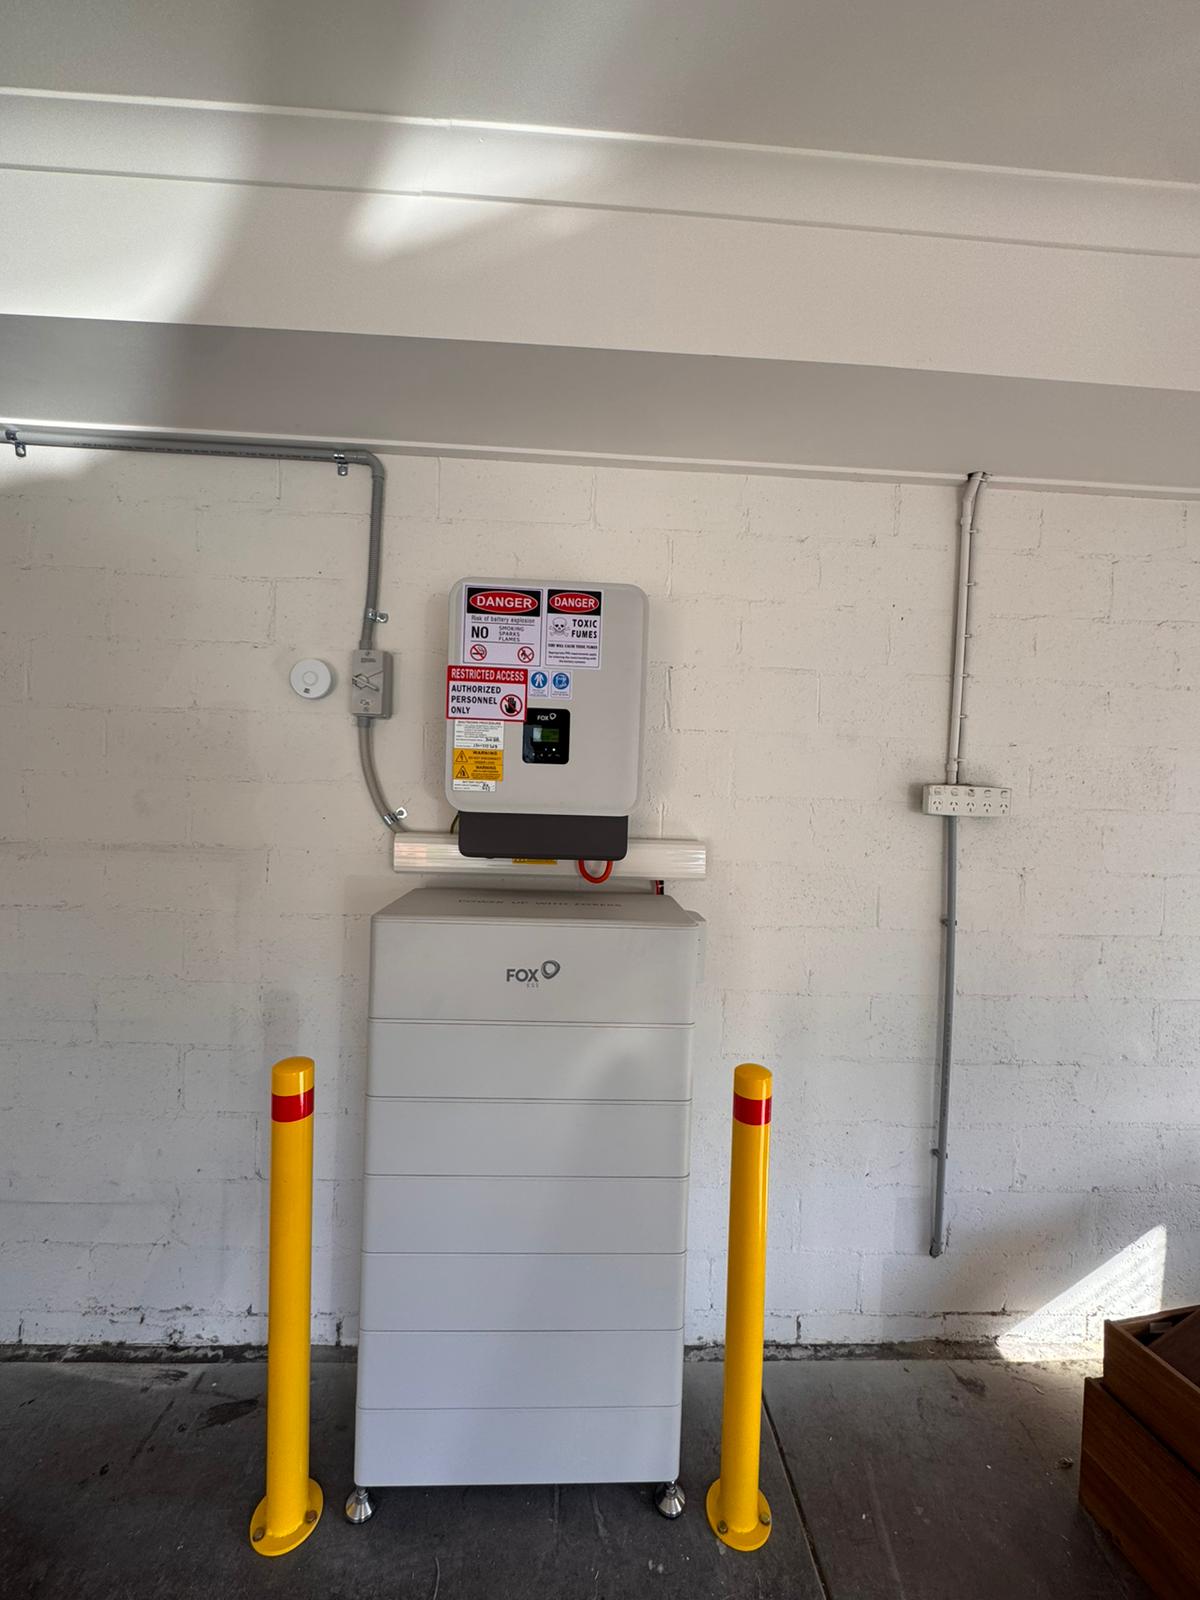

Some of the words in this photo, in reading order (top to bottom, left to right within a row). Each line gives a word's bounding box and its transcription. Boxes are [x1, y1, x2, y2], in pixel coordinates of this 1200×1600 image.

[476, 596, 532, 608] DANGER
[554, 597, 596, 608] DANGER
[572, 619, 598, 628] TOXIC
[472, 626, 489, 639] NO
[571, 630, 598, 639] FUMES
[451, 668, 495, 680] RESTRICTED
[496, 670, 524, 681] ACCESS
[451, 684, 501, 694] AUTHORIZED
[451, 696, 498, 705] PERSONNEL
[451, 706, 470, 714] ONLY
[506, 969, 539, 982] FOX
